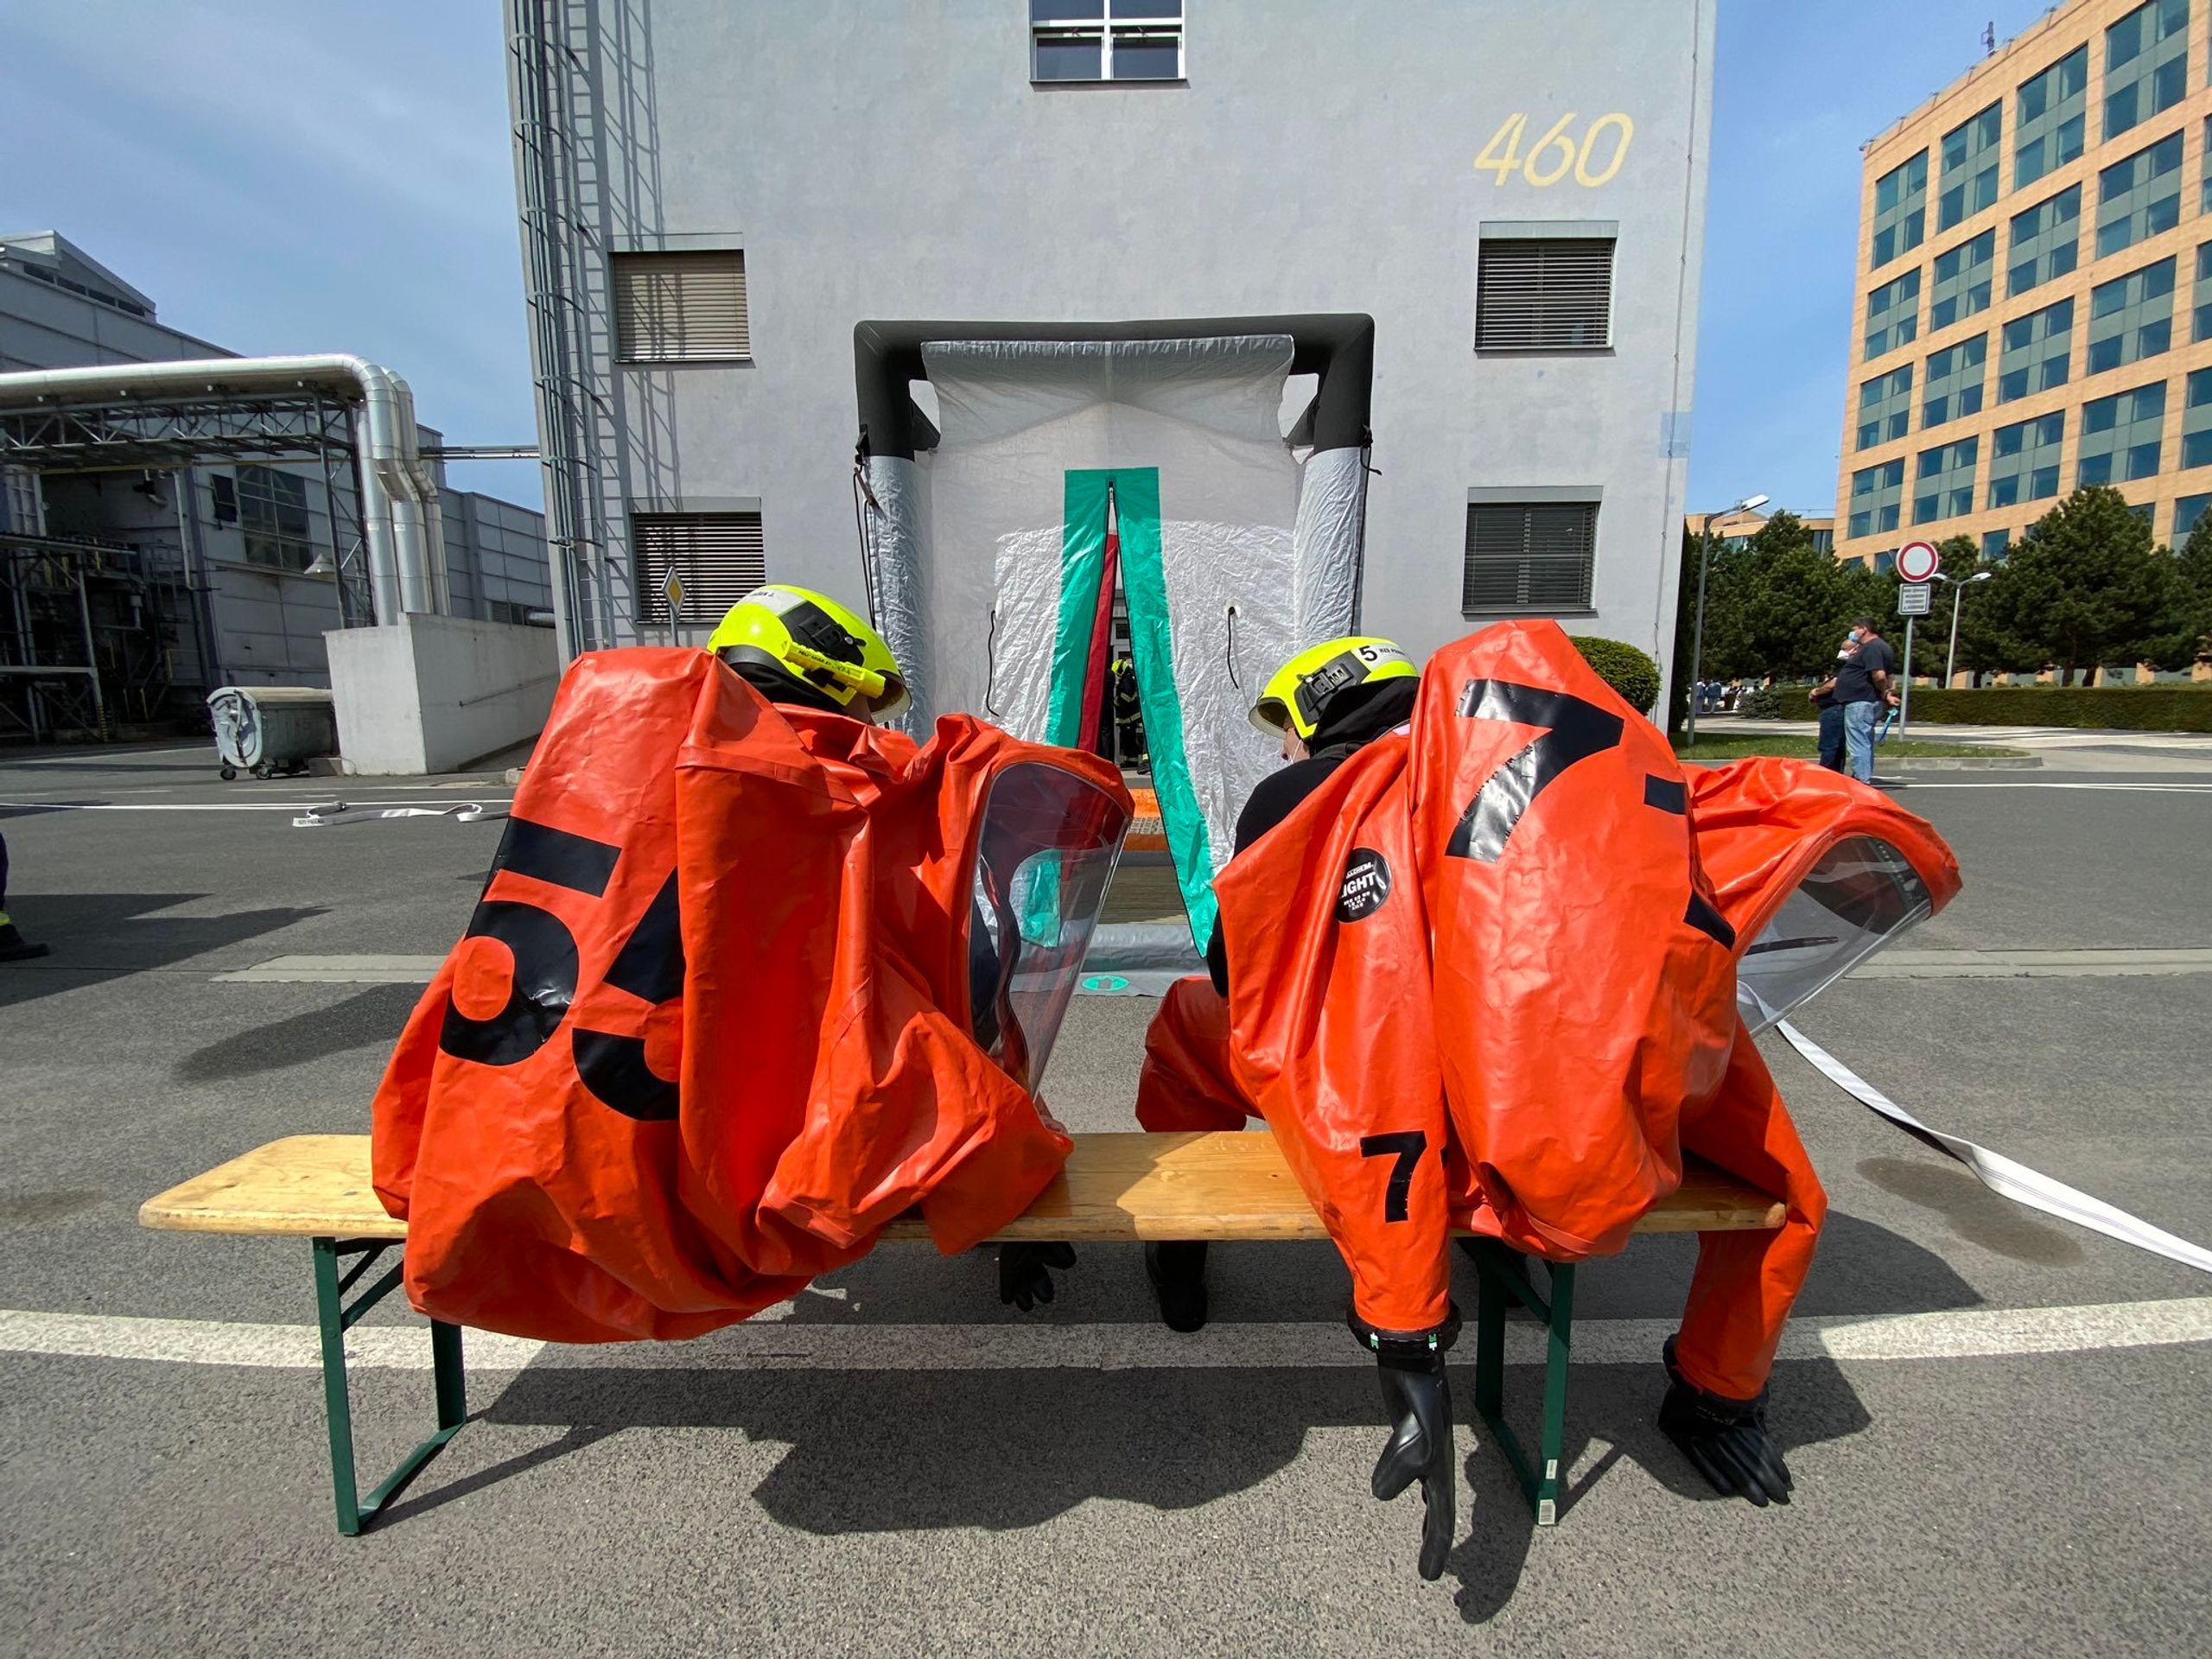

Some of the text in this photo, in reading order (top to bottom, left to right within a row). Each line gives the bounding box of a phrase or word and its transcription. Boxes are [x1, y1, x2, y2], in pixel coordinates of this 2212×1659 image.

[1473, 111, 1634, 188] 460
[1359, 645, 1378, 662] 5
[1340, 871, 1376, 899] IGHT
[1359, 1129, 1449, 1224] 7
